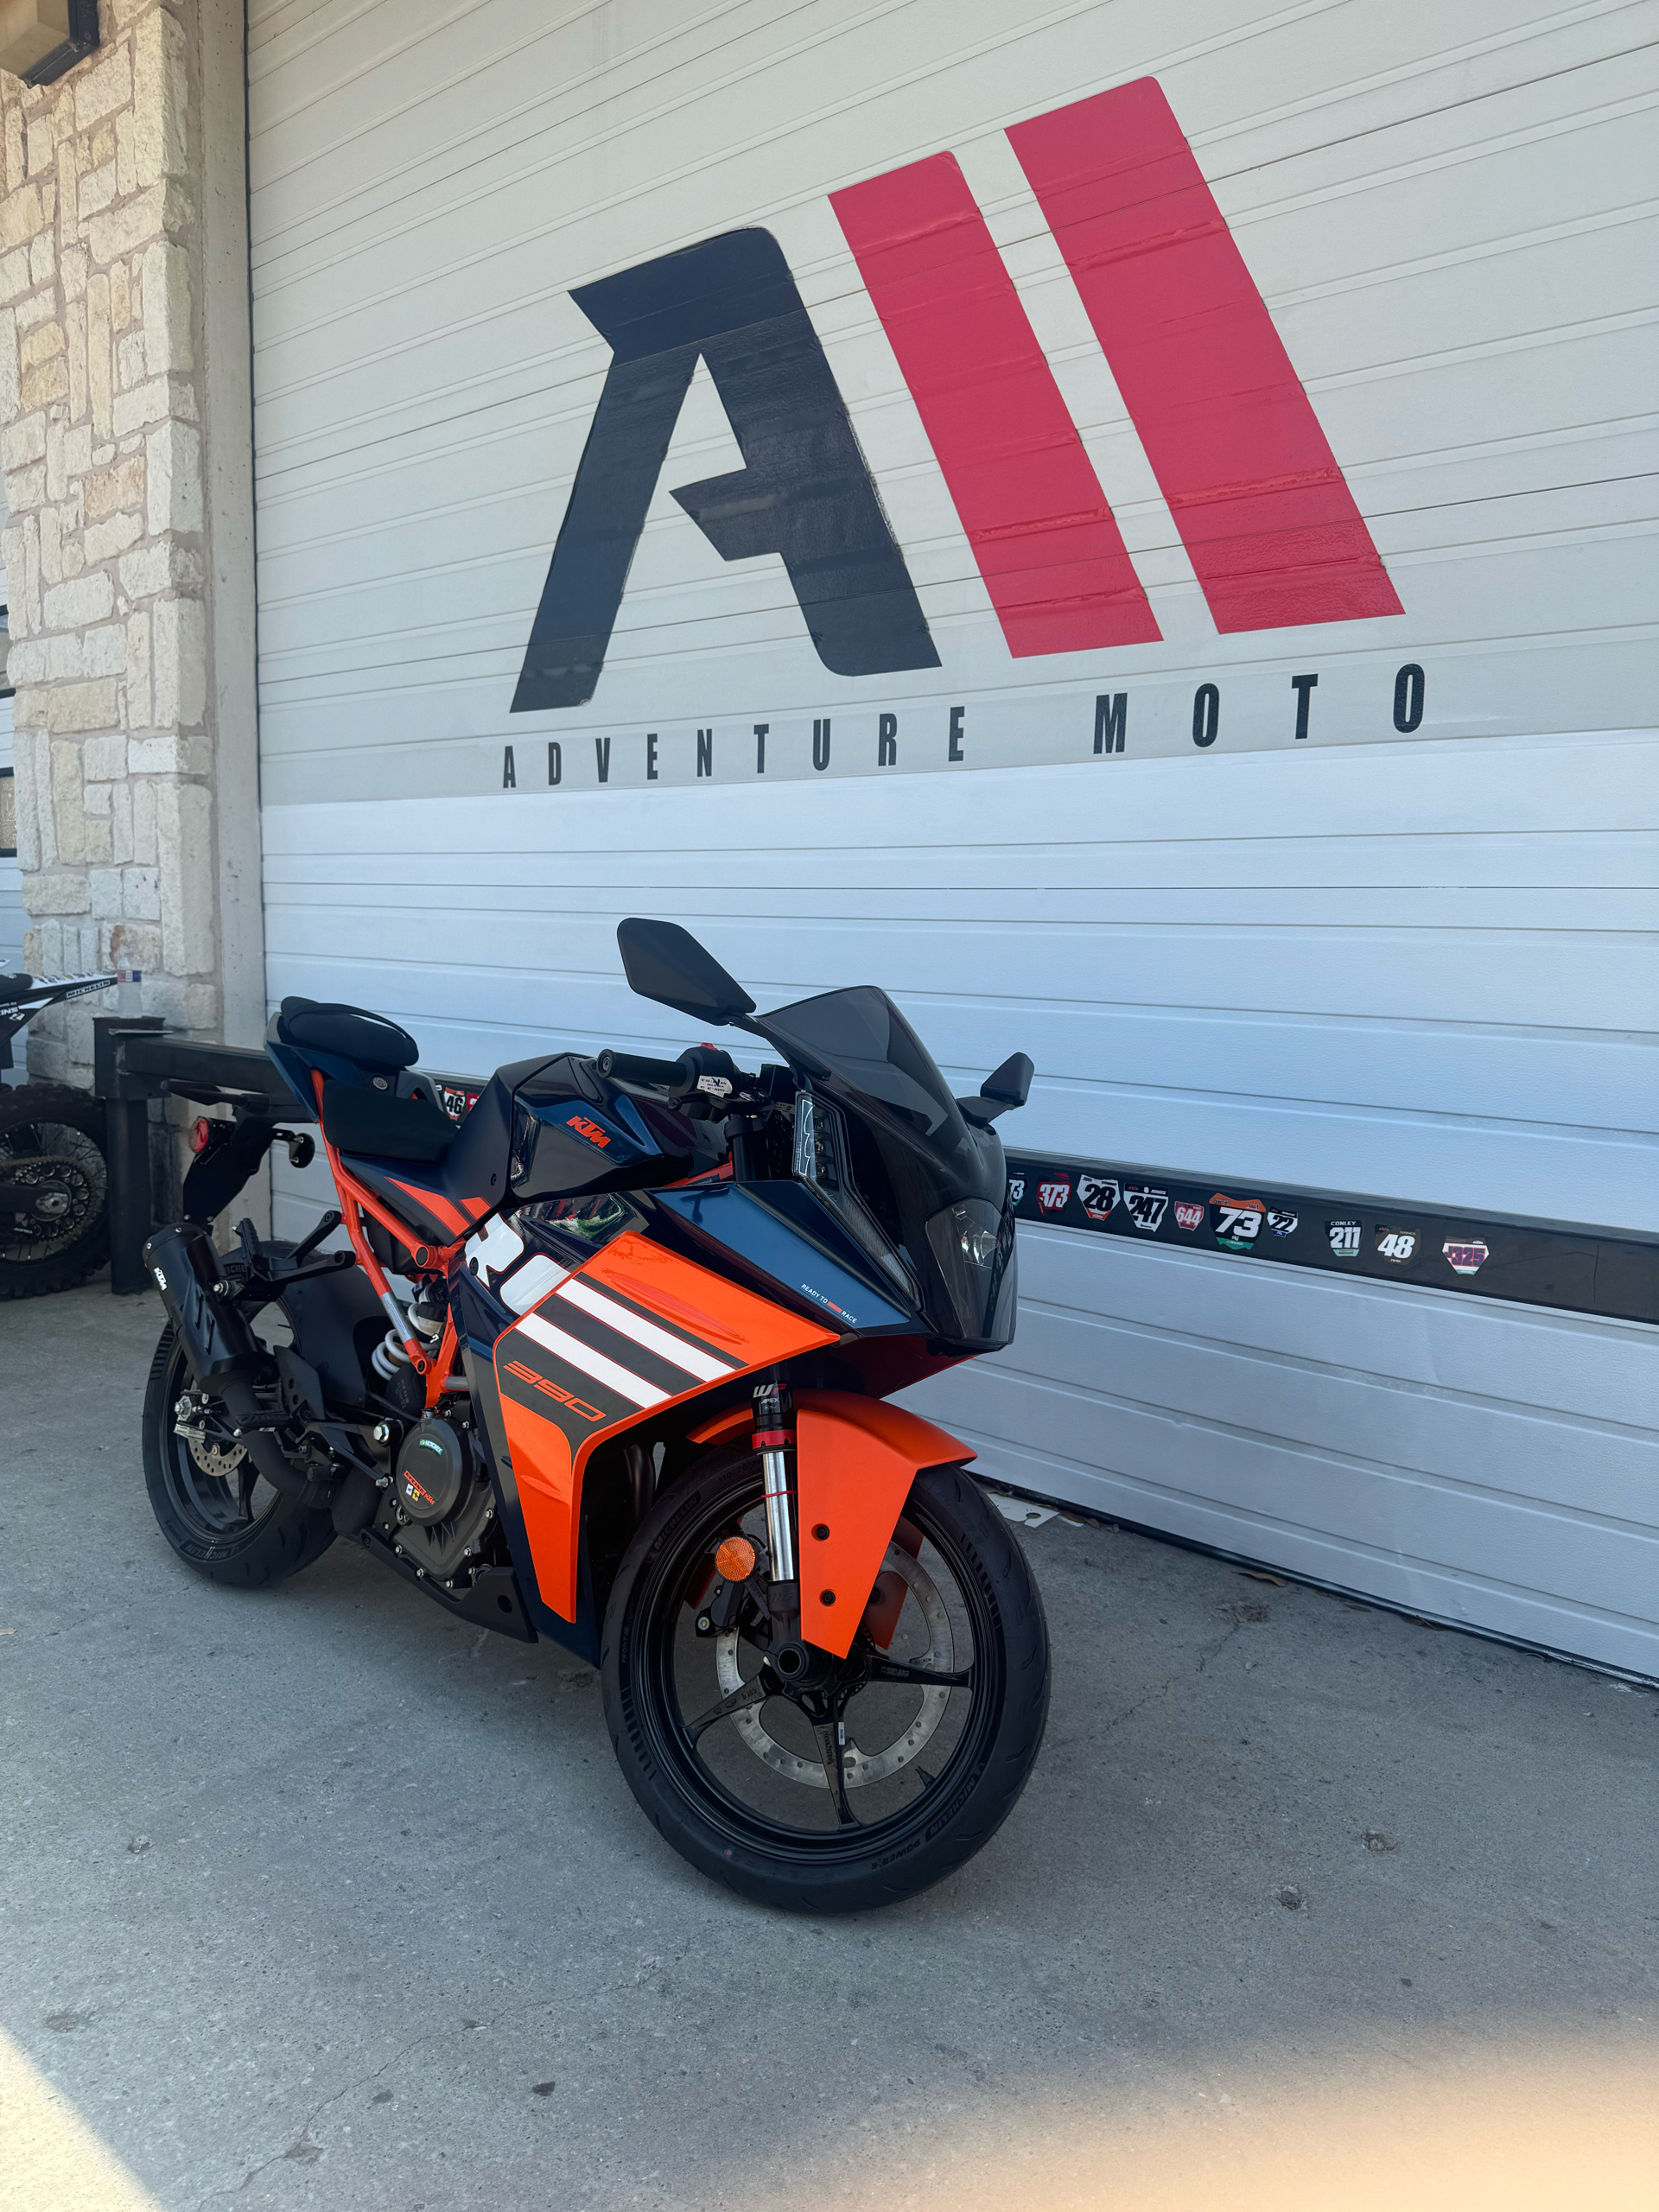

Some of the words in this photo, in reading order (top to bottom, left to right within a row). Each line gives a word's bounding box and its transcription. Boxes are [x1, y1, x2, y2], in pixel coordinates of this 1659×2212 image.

[502, 705, 965, 790] ADVENTURE
[1092, 663, 1426, 755] MOTO
[67, 979, 111, 998] MICHELIN
[0, 1007, 18, 1016] INS
[446, 1096, 464, 1115] 46
[566, 1116, 612, 1148] KTM
[1039, 1184, 1070, 1208] 373
[1083, 1183, 1116, 1211] 28
[1128, 1195, 1166, 1224] 247
[1176, 1206, 1202, 1226] 644
[1215, 1206, 1262, 1238] 73
[1270, 1214, 1294, 1233] 22
[1329, 1227, 1361, 1249] 211
[1377, 1233, 1415, 1259] 48
[154, 1267, 168, 1291] KTM
[801, 1283, 821, 1299] READY
[820, 1295, 829, 1304] TO
[841, 1310, 858, 1324] RACE
[503, 1360, 607, 1422] 390
[653, 1496, 698, 1551] MICHELIN
[929, 1776, 976, 1835] MICHELIN
[882, 1838, 921, 1866] POWER
